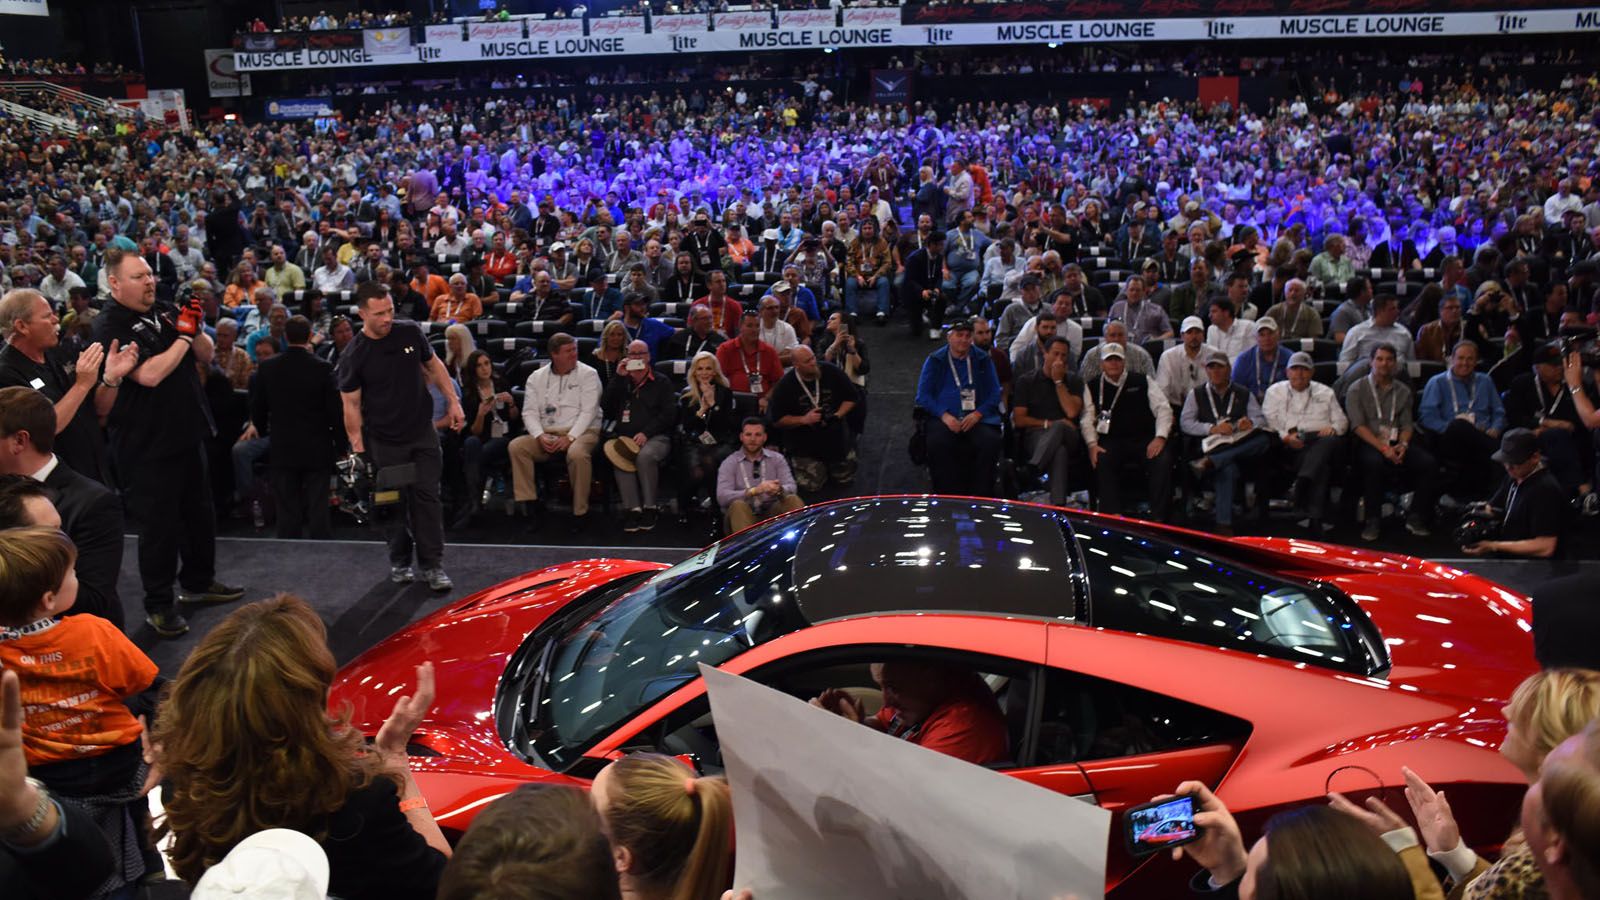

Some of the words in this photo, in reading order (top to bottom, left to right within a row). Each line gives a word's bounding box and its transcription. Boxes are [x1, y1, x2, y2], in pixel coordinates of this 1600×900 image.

[997, 24, 1073, 40] MUSCLE
[1079, 22, 1155, 39] LOUNGE
[1206, 20, 1235, 39] Lite
[1280, 18, 1359, 34] MUSCLE
[1365, 16, 1445, 32] LOUNGE
[1497, 14, 1528, 33] Lite
[671, 34, 698, 52] Lite
[739, 31, 812, 47] MUSCLE
[819, 28, 892, 45] LOUNGE
[926, 27, 953, 45] Lite
[417, 43, 442, 63] Lite
[481, 40, 549, 57] MUSCLE
[556, 38, 624, 55] LOUNGE
[239, 52, 303, 68] MUSCLE
[309, 48, 373, 66] LOUNGE
[20, 655, 36, 665] ON
[40, 652, 63, 664] THIS
